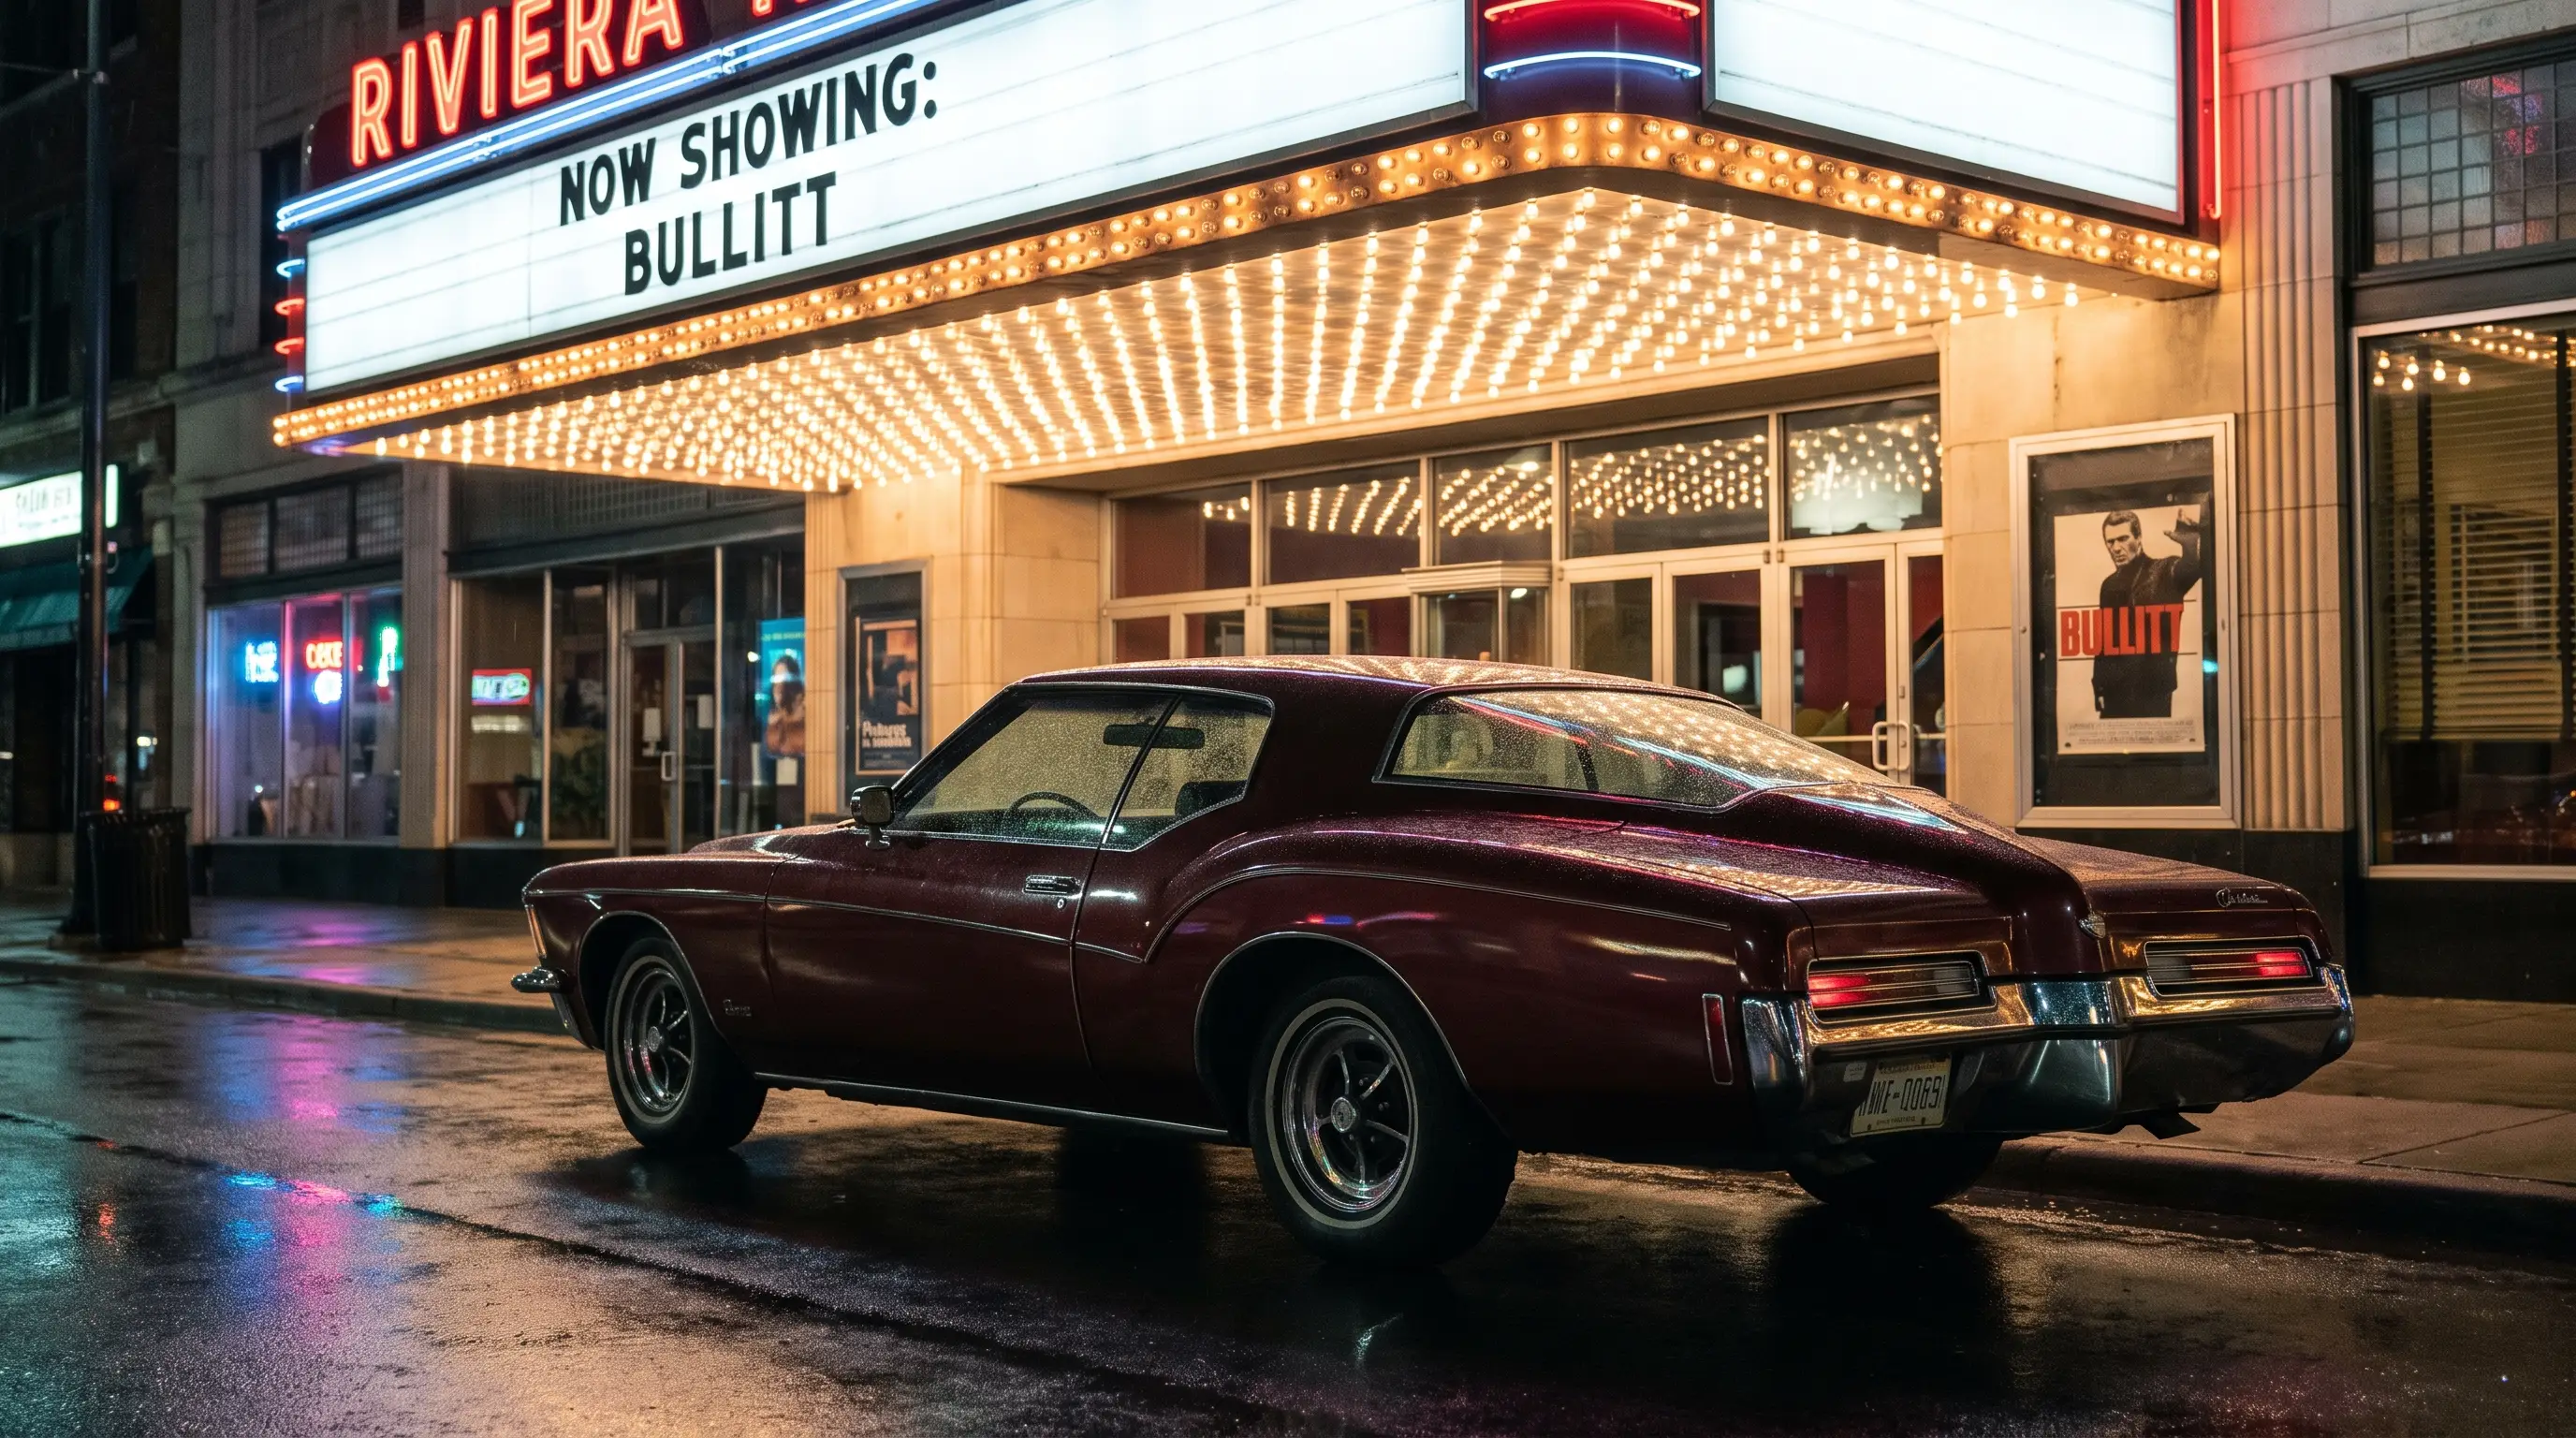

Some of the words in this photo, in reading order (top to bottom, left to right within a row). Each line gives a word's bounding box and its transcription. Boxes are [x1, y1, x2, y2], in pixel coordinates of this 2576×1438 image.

[351, 0, 684, 168] RIVIERA
[560, 137, 656, 227] NOW
[681, 52, 938, 189] SHOWING:
[624, 171, 837, 296] BULLITT
[2060, 603, 2184, 657] BULLITT
